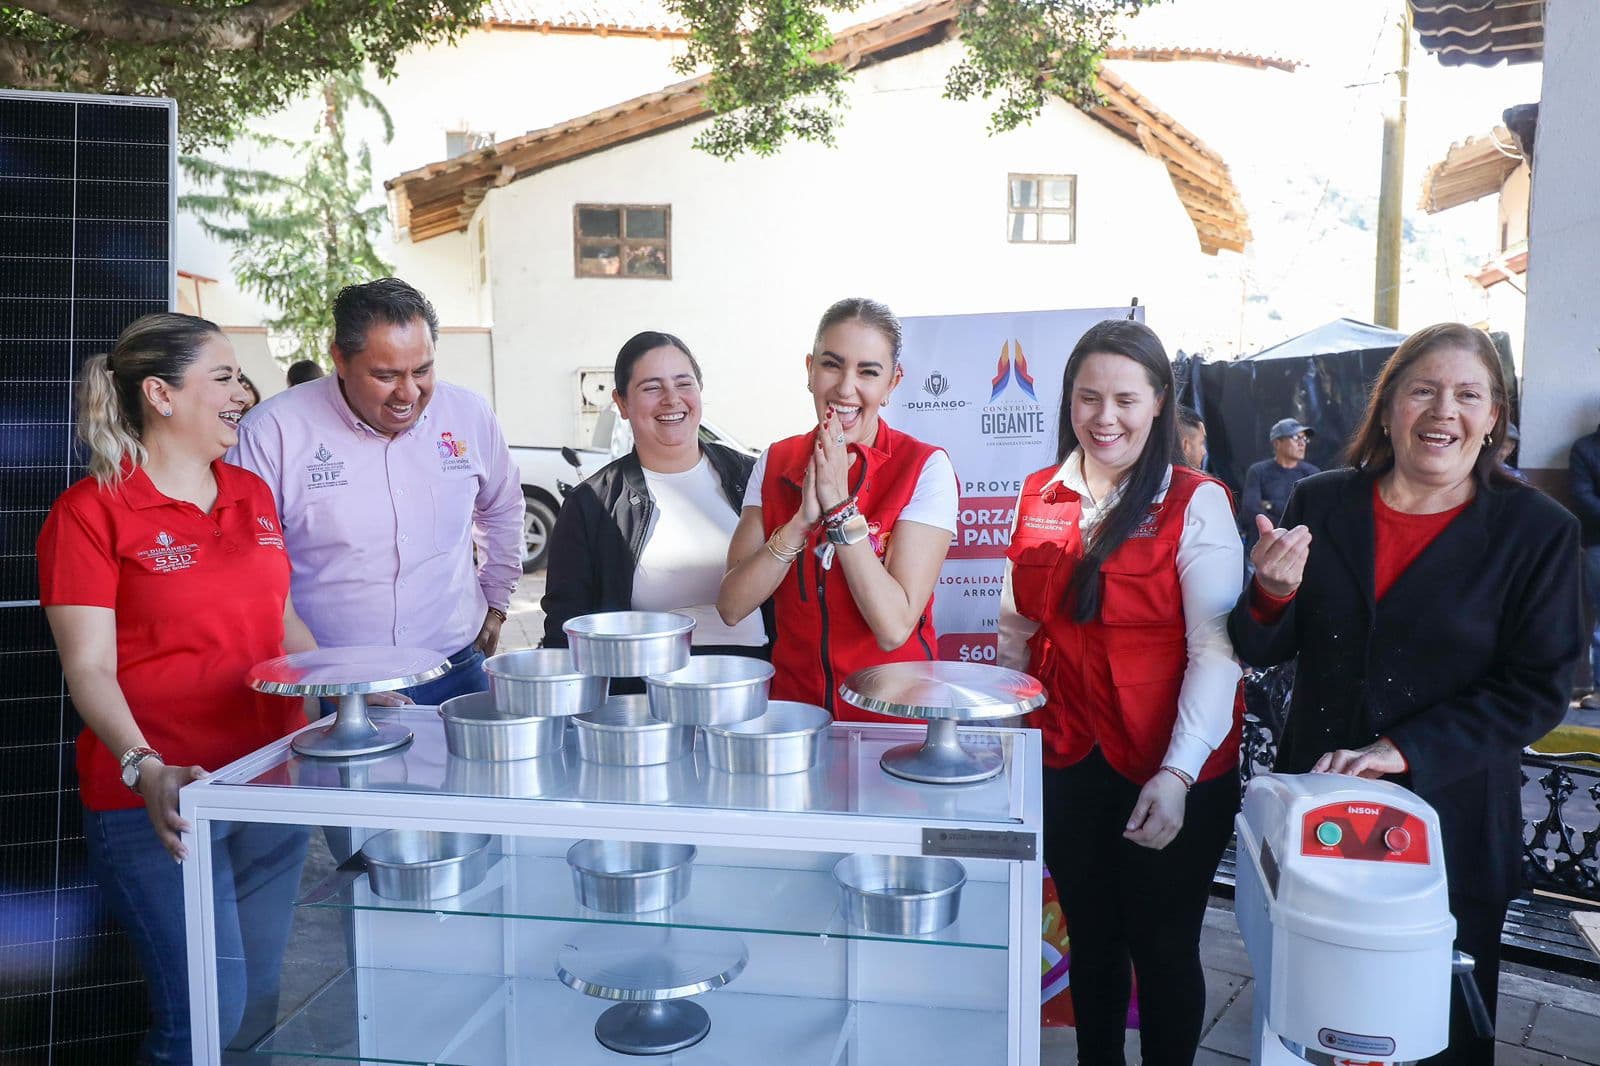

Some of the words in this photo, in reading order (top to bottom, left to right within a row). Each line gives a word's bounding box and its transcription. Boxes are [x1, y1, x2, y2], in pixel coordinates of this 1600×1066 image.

[908, 400, 966, 409] DURANGO
[983, 404, 1041, 412] CONSTRUYE
[981, 412, 1045, 434] GIGANTE
[311, 471, 341, 482] DIF
[965, 481, 1020, 492] PROYE
[964, 528, 1009, 546] PAN
[155, 554, 192, 567] SSD
[963, 589, 1002, 597] ARROY
[959, 644, 996, 661] $60
